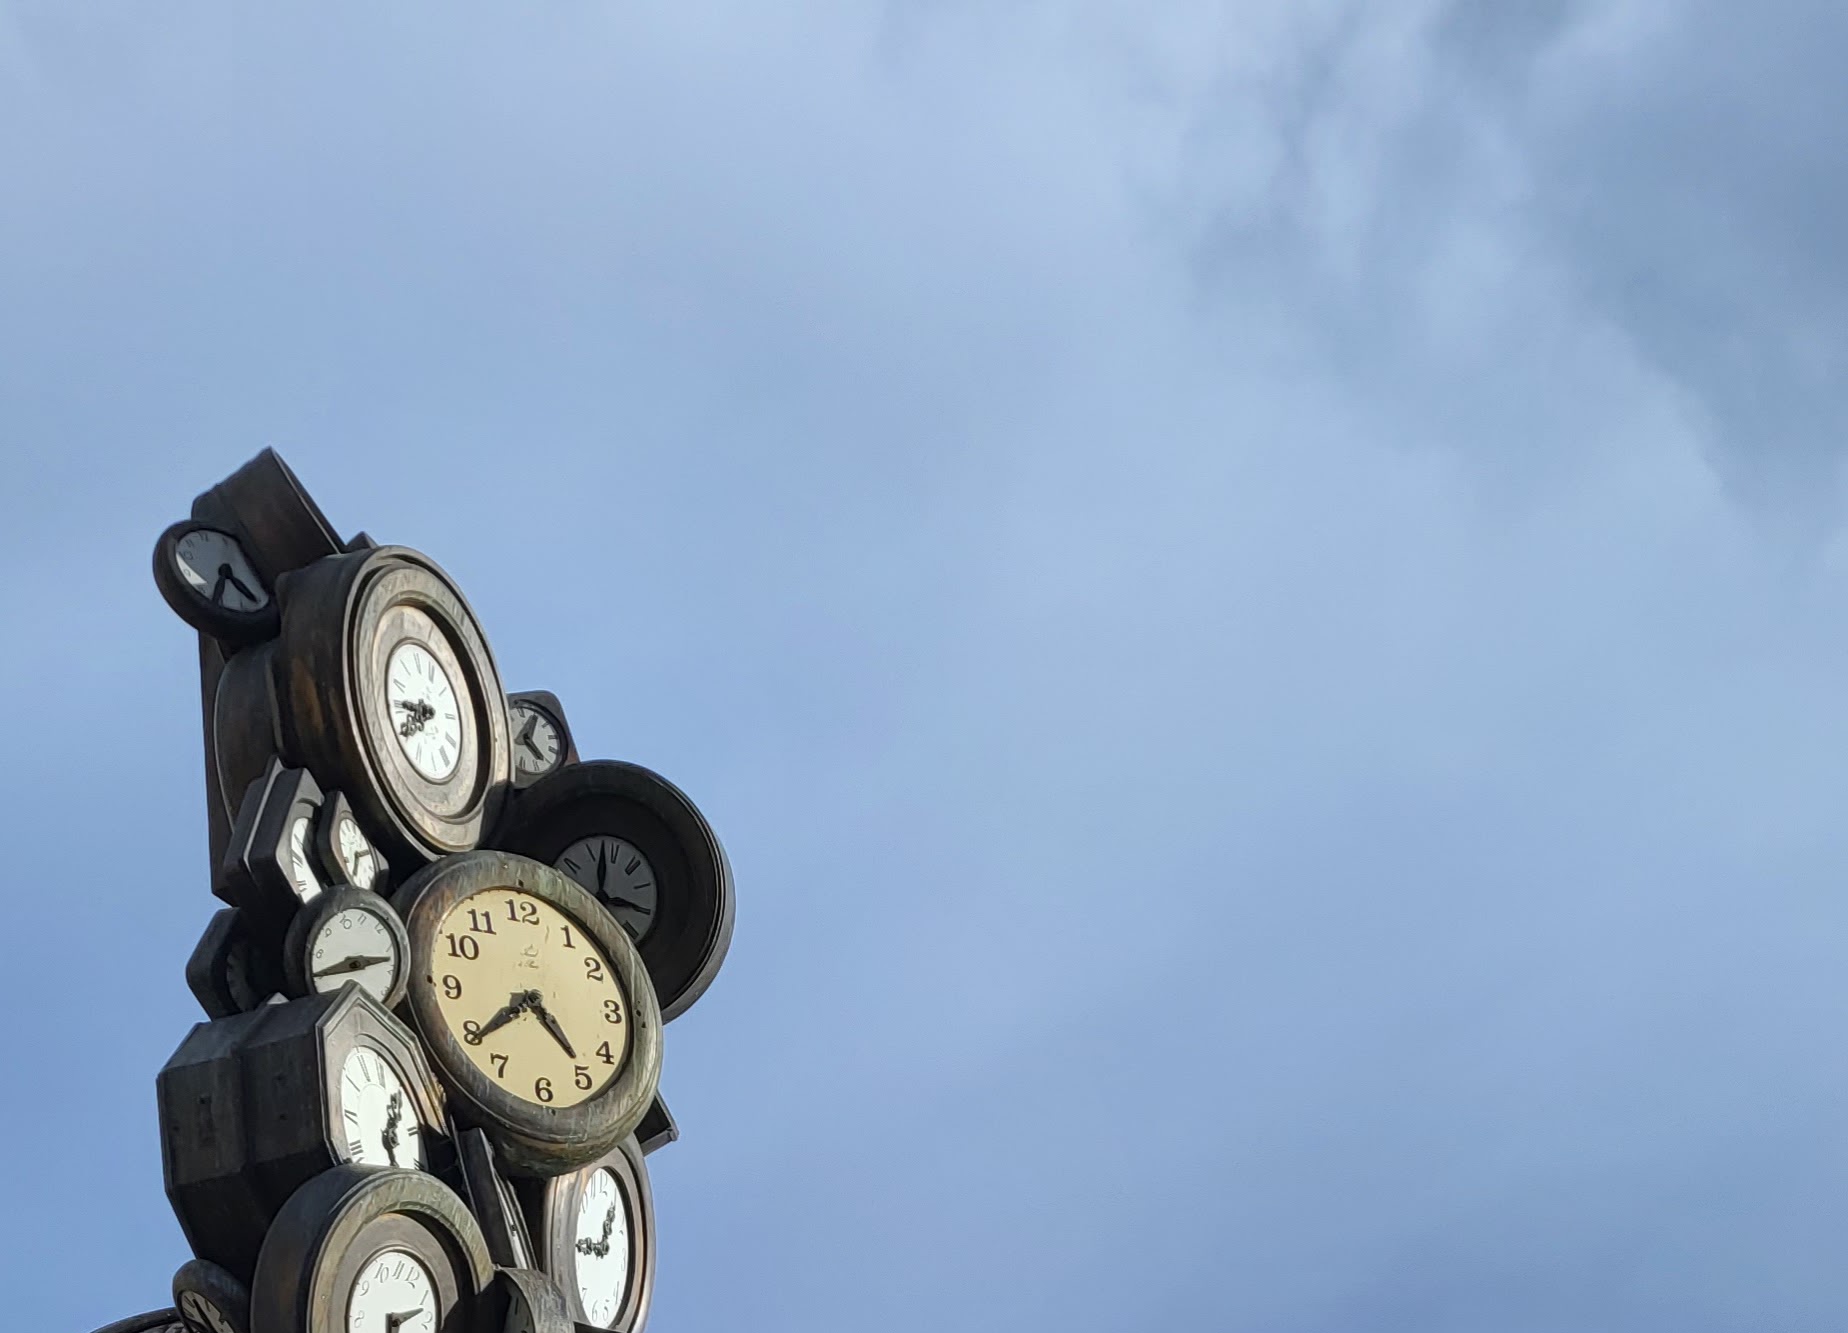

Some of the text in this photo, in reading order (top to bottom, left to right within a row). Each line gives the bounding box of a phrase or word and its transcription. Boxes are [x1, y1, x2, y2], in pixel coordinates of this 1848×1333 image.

[467, 908, 497, 935] 11
[504, 899, 540, 926] 12
[445, 933, 480, 960] 10
[560, 925, 576, 949] 1
[584, 957, 604, 982] 2
[442, 974, 462, 1000] 9
[604, 1000, 622, 1024] 3
[463, 1020, 483, 1046] 8
[596, 1040, 615, 1064] 4
[490, 1053, 509, 1078] 7
[575, 1065, 592, 1090] 5
[535, 1077, 553, 1102] 6
[374, 1263, 389, 1283] 10
[392, 1261, 404, 1279] 11
[405, 1266, 420, 1288] 12
[360, 1281, 369, 1296] 9
[420, 1290, 428, 1305] 1
[354, 1310, 365, 1328] 8
[421, 1311, 432, 1330] 2
